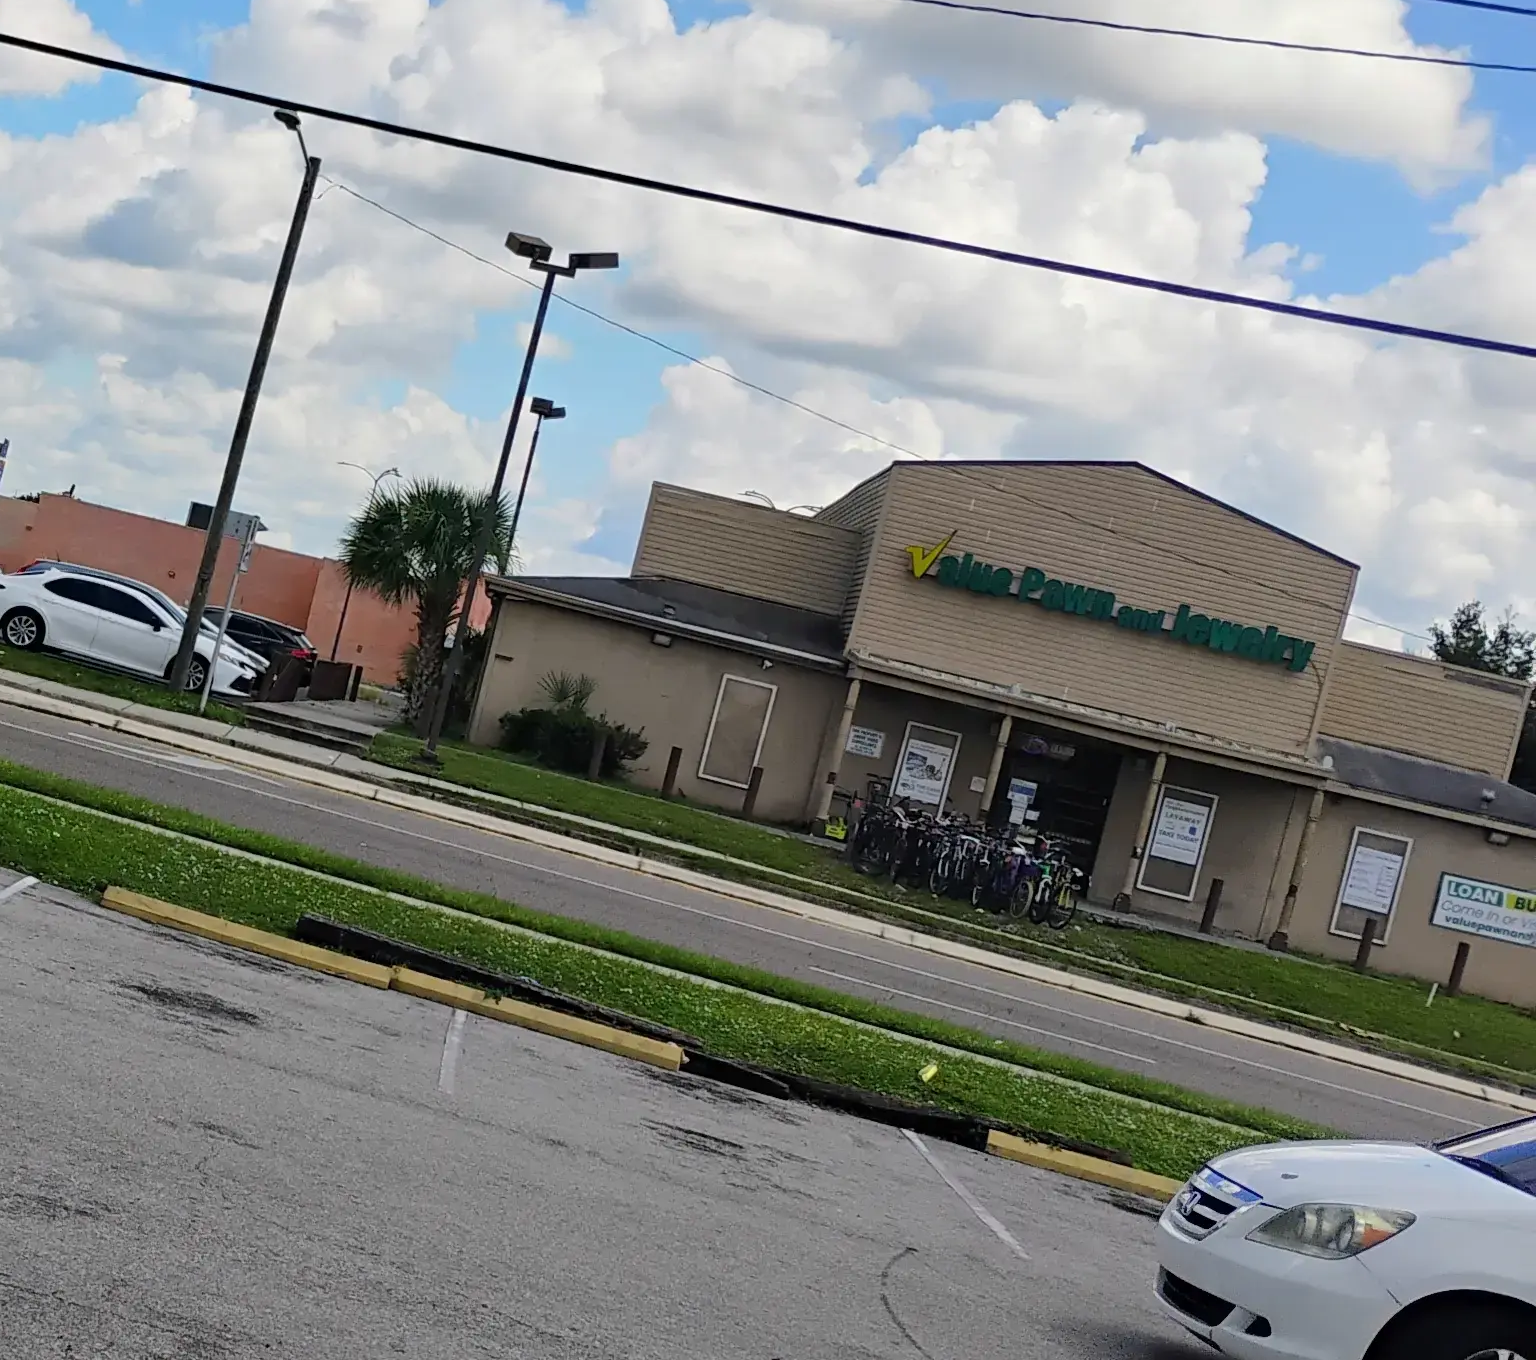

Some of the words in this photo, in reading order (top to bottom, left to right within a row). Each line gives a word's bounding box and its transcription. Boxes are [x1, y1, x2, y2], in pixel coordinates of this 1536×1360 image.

[906, 530, 1014, 597] Value
[1018, 566, 1116, 621] Pawn
[1117, 605, 1165, 633] and
[1171, 604, 1316, 672] Jewelry
[1165, 812, 1201, 825] LAYAWAY
[1449, 882, 1500, 905] LOAN
[1441, 900, 1484, 919] Come
[1502, 915, 1518, 925] or
